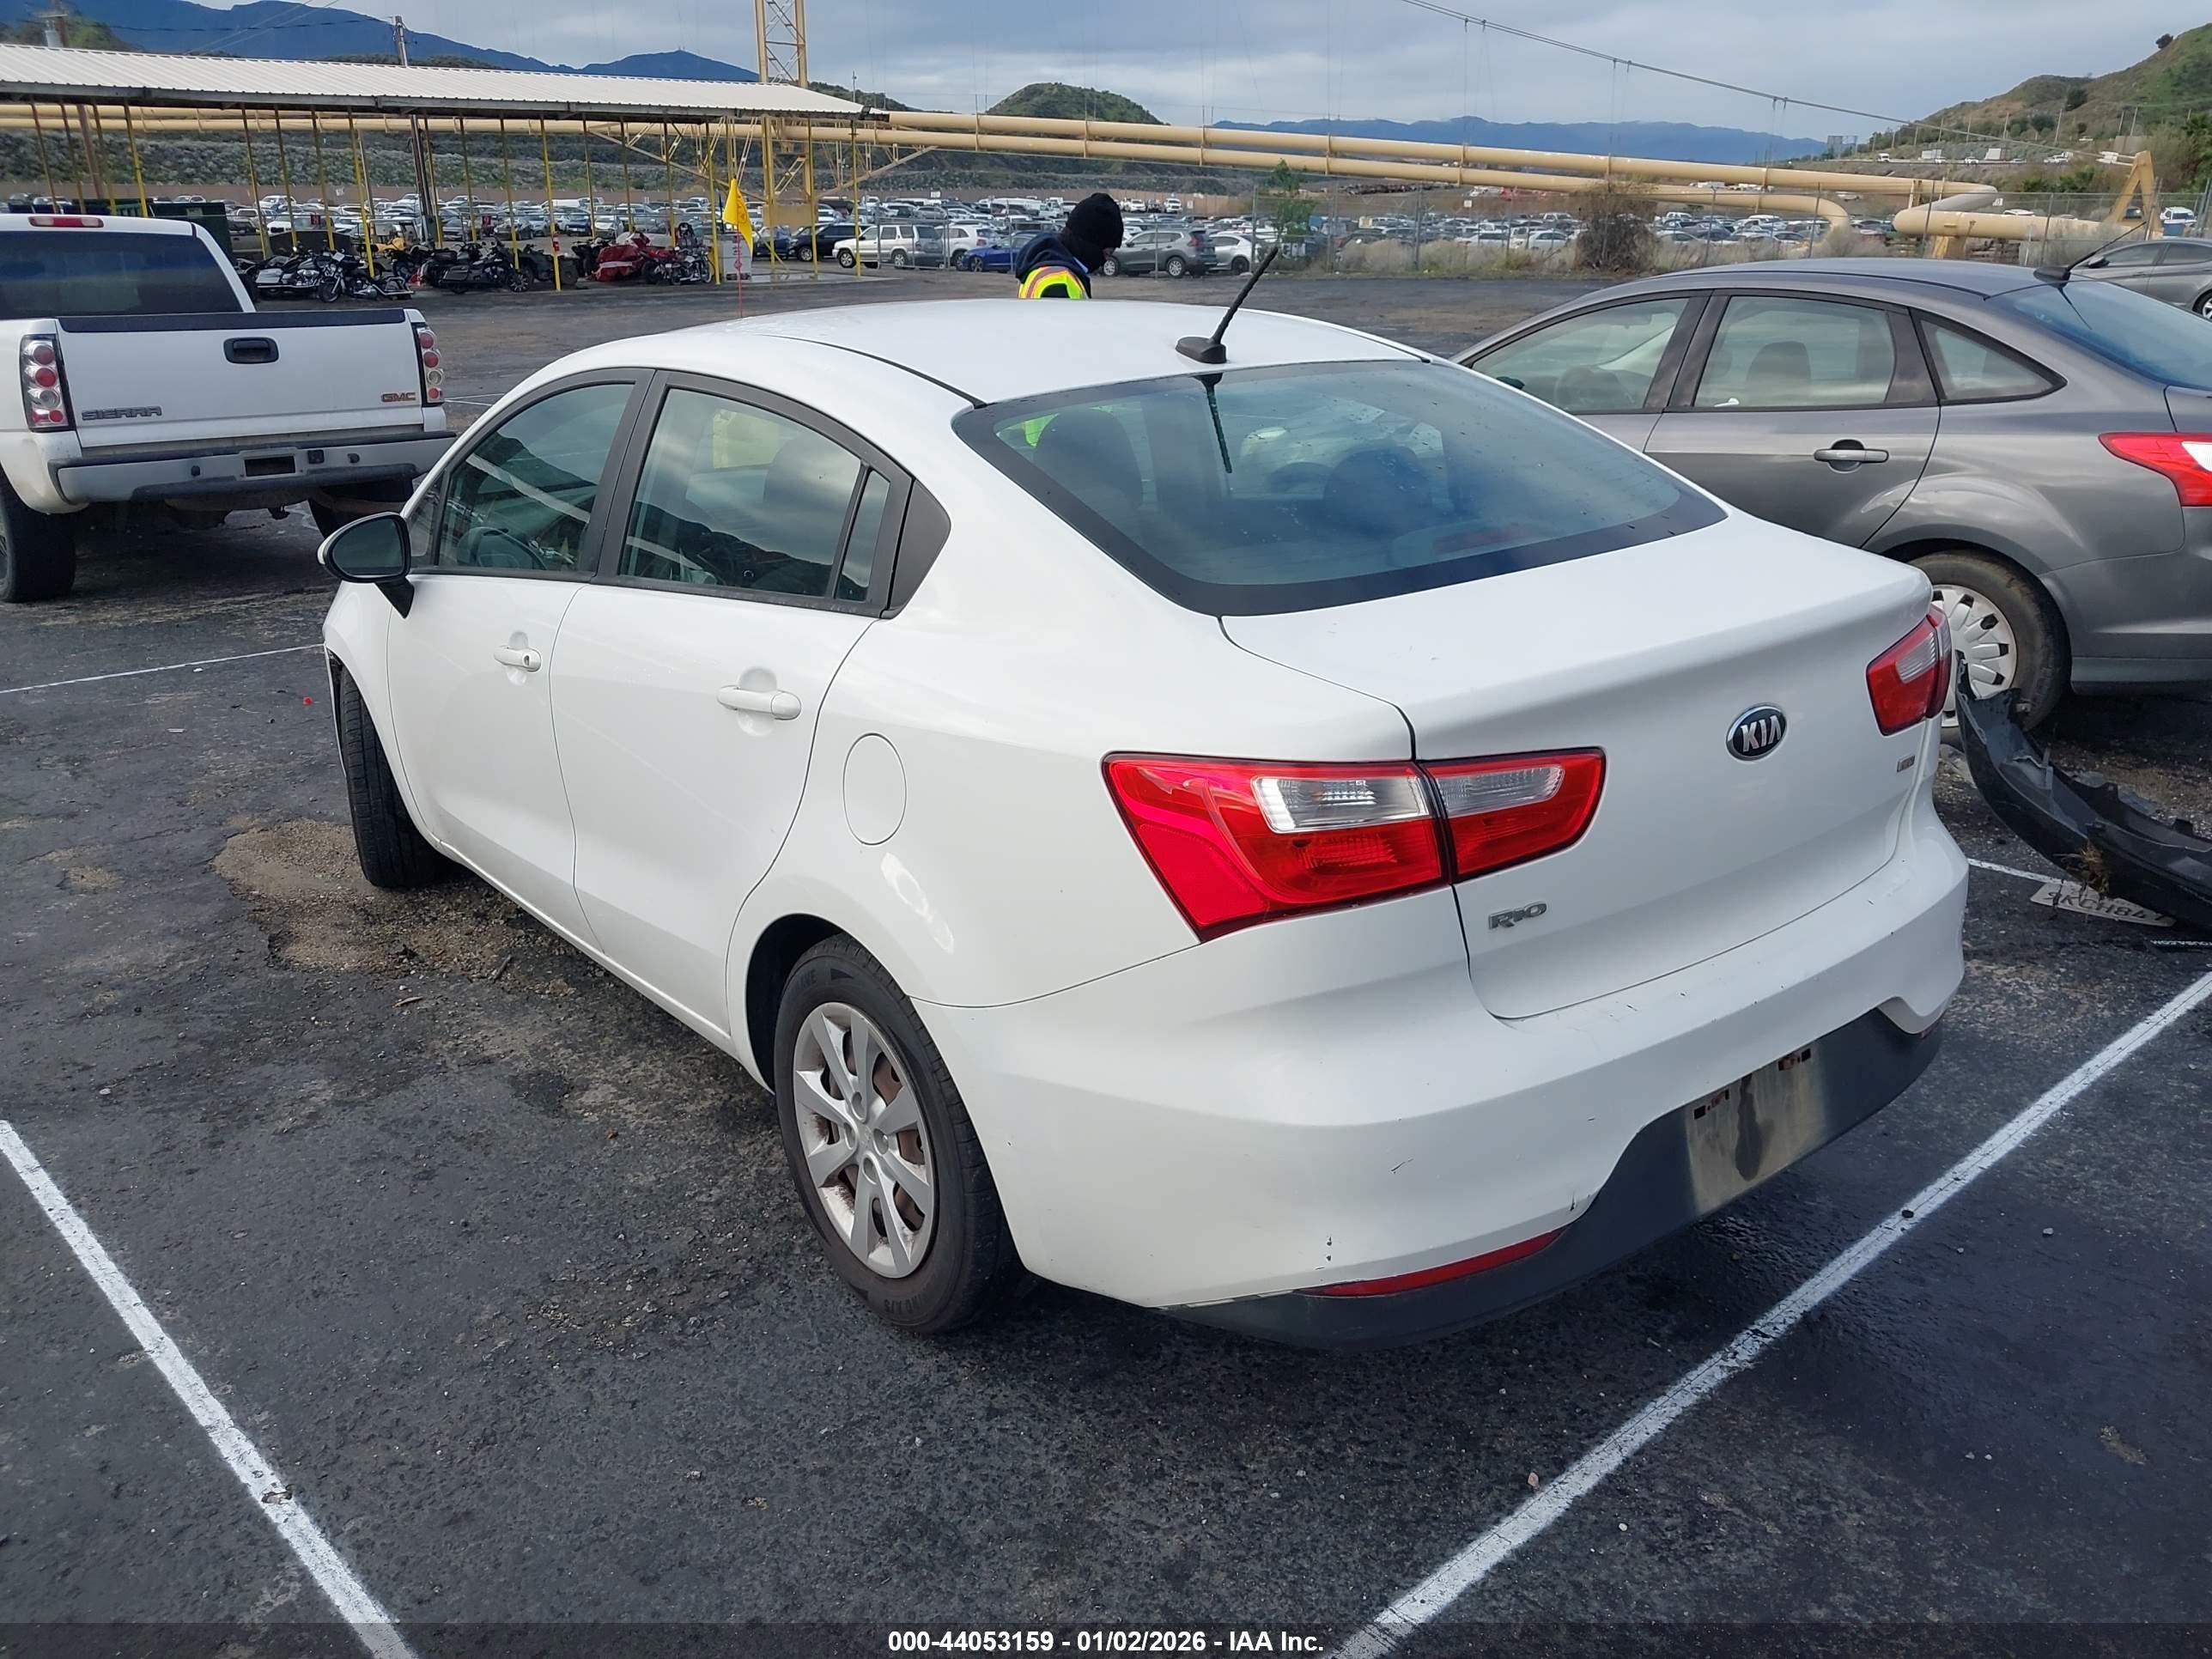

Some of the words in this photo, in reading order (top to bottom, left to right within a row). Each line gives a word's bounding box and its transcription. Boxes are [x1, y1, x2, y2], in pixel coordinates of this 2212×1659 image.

[380, 392, 416, 403] GMC
[81, 406, 162, 421] SIERRA
[1740, 714, 1782, 752] KIA
